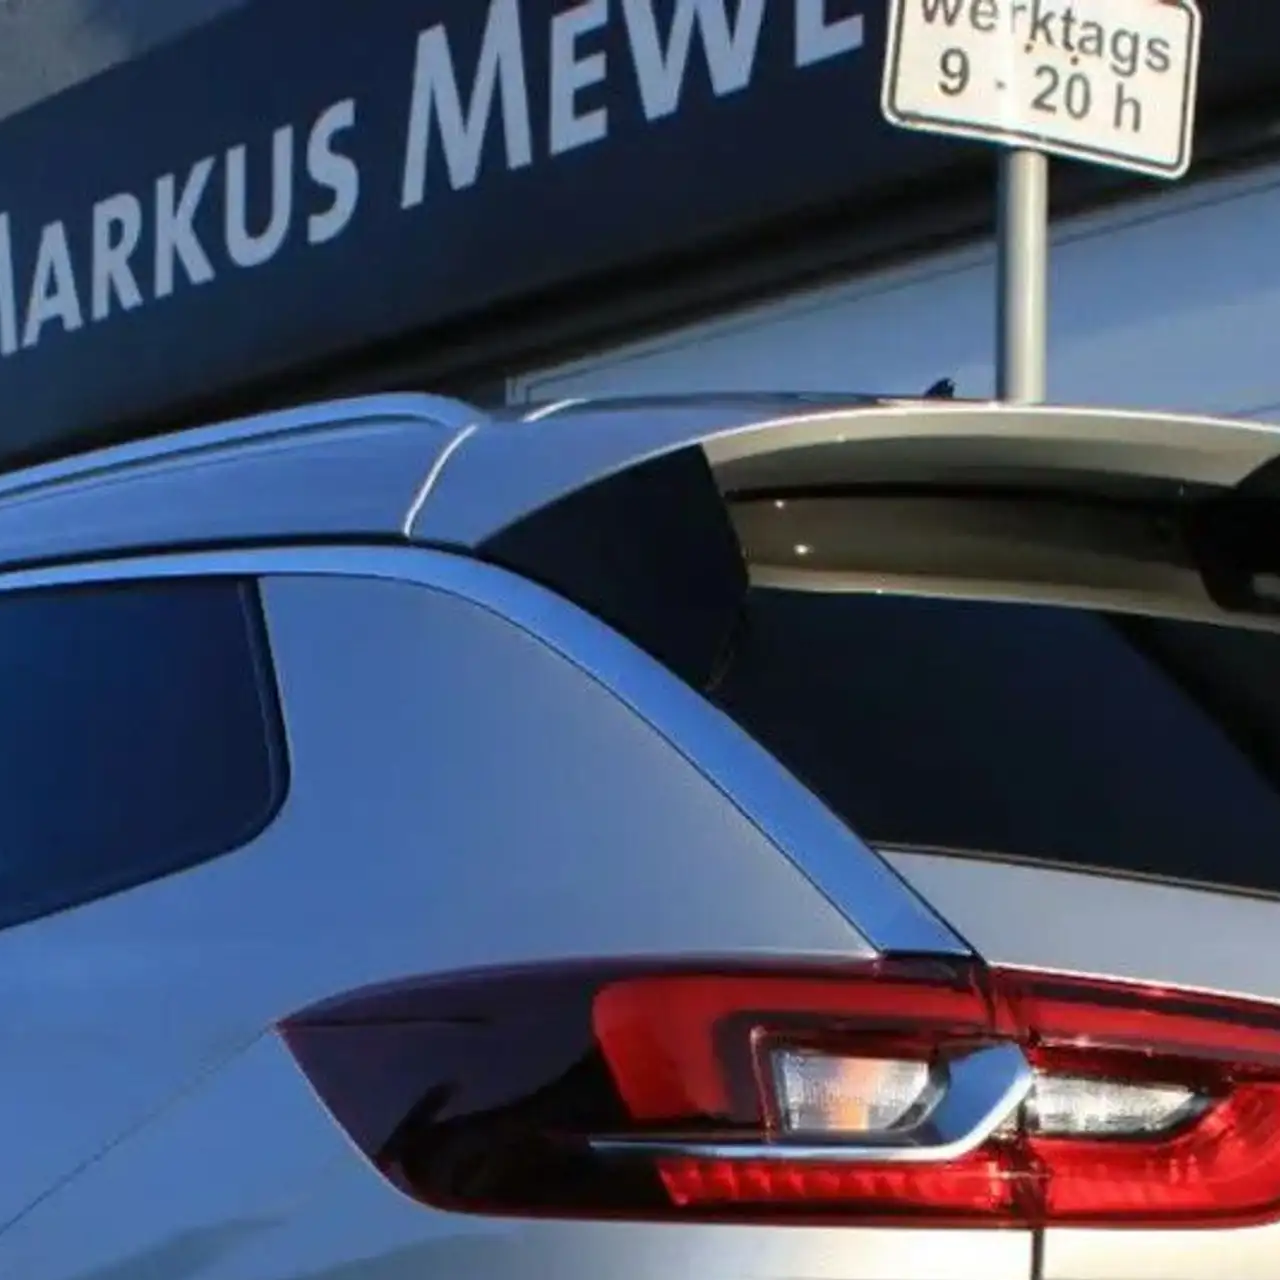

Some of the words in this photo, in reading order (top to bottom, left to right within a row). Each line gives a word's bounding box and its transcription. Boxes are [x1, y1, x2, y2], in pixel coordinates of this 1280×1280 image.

[937, 48, 970, 96] 9
[1031, 65, 1092, 120] 20
[1113, 83, 1143, 133] h
